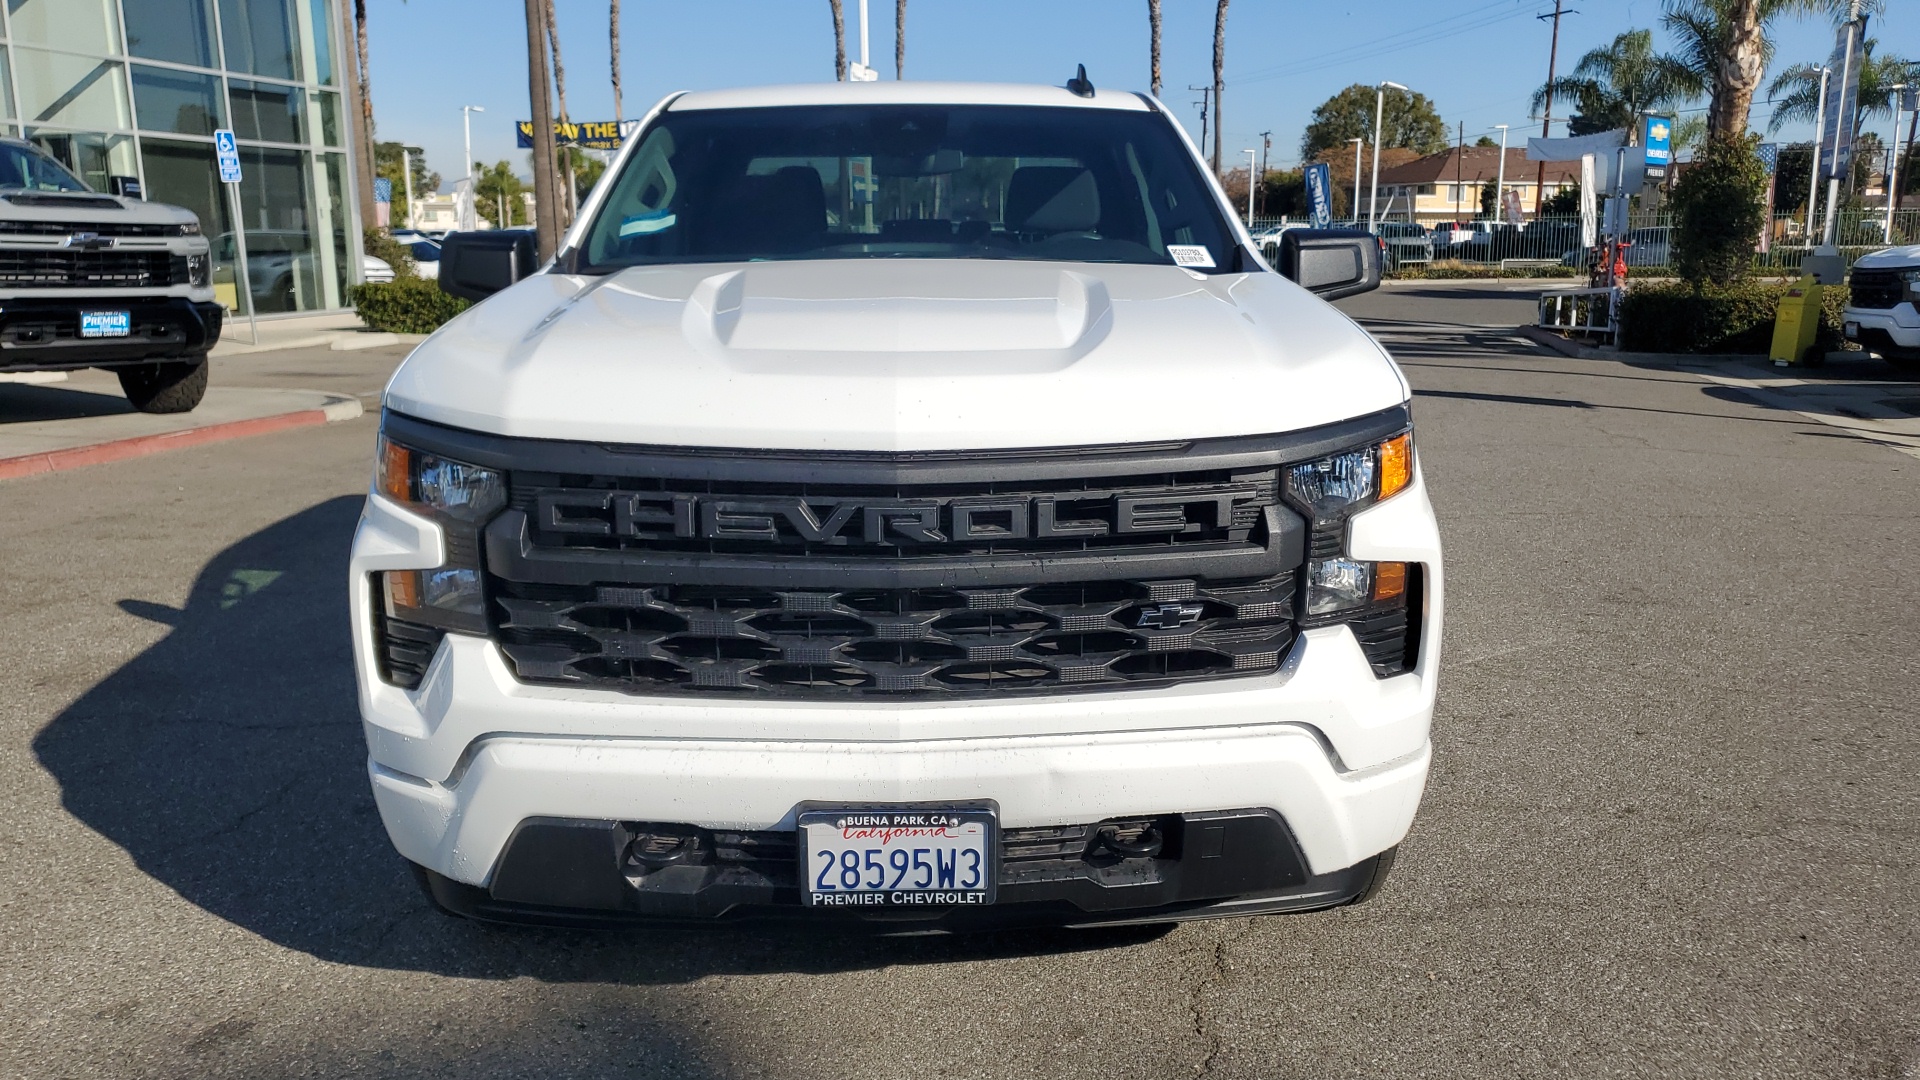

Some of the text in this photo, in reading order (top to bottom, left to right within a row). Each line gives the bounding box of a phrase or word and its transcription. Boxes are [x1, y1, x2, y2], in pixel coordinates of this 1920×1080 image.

[583, 123, 618, 138] THE
[83, 315, 127, 327] PREMIER
[536, 488, 1255, 545] CHEVROLET
[847, 816, 948, 826] BUENA PARK, CA
[843, 827, 959, 845] California
[816, 848, 981, 890] 28595W3
[812, 892, 986, 906] PREMIER CHEVROLET
